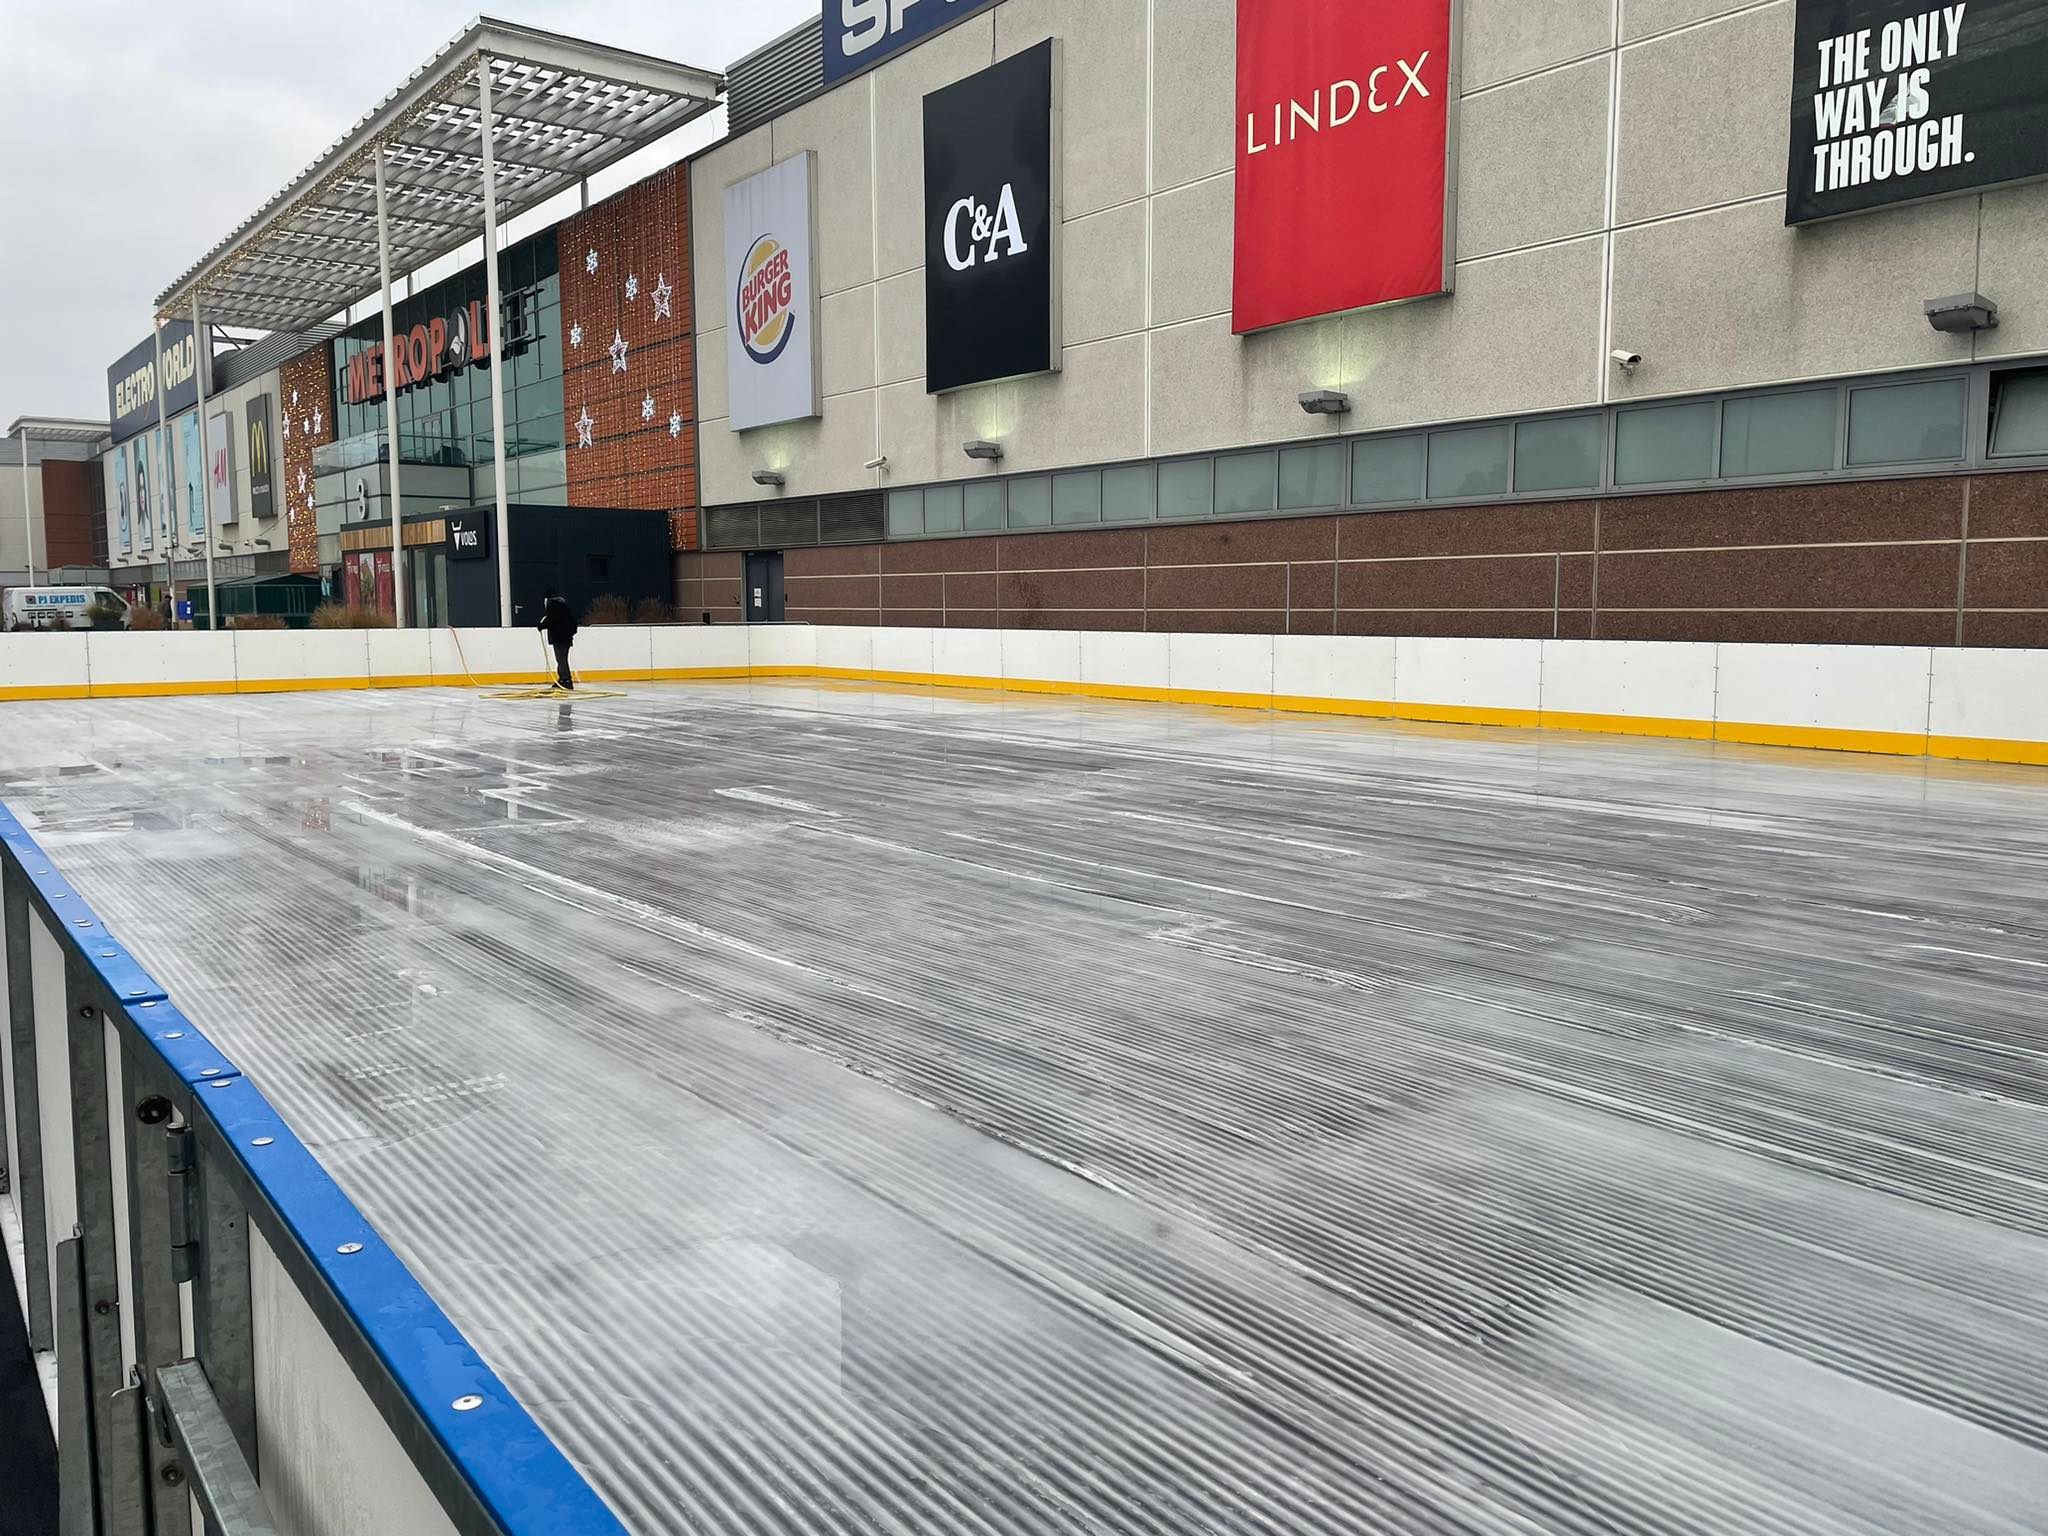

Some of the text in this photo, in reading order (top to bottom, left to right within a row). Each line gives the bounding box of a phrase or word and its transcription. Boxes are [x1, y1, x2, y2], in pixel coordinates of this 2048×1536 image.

[1818, 2, 1966, 89] THE ONLY
[1247, 50, 1430, 155] LINDEX
[1813, 67, 1931, 141] WAY IS
[1813, 113, 1975, 193] THROUGH.
[943, 183, 1028, 271] C&A
[742, 248, 789, 313] BURGER
[745, 271, 792, 345] KING
[115, 334, 195, 420] ELECTRO ORLD
